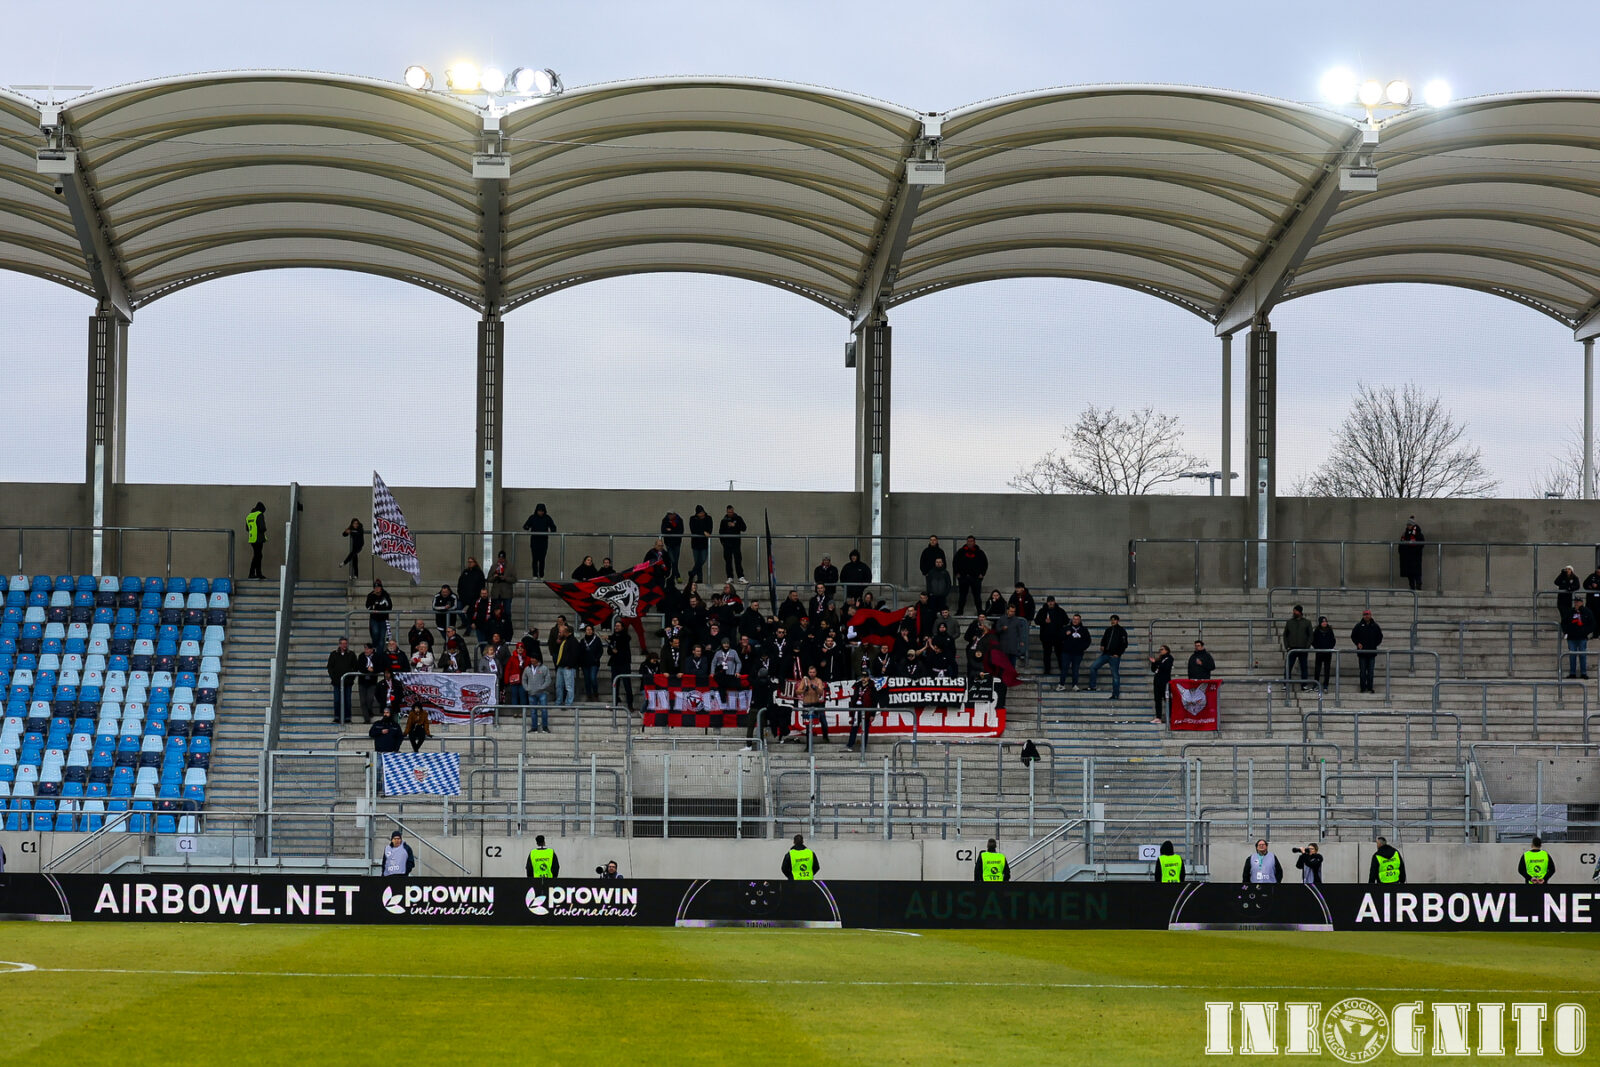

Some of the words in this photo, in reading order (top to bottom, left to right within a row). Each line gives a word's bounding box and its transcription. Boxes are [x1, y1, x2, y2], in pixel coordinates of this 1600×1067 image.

[888, 677, 965, 688] SUPPORTERS
[889, 693, 968, 704] INGOLSTADT
[21, 841, 37, 854] C1
[180, 839, 193, 850] C1
[485, 846, 502, 857] C2
[956, 850, 972, 861] C2
[1143, 848, 1156, 857] C2
[1580, 853, 1596, 864] C3
[94, 883, 360, 916] AIRBOWL.NET
[905, 890, 1108, 920] AUSATMEN
[410, 903, 494, 916] international
[553, 904, 638, 917] international
